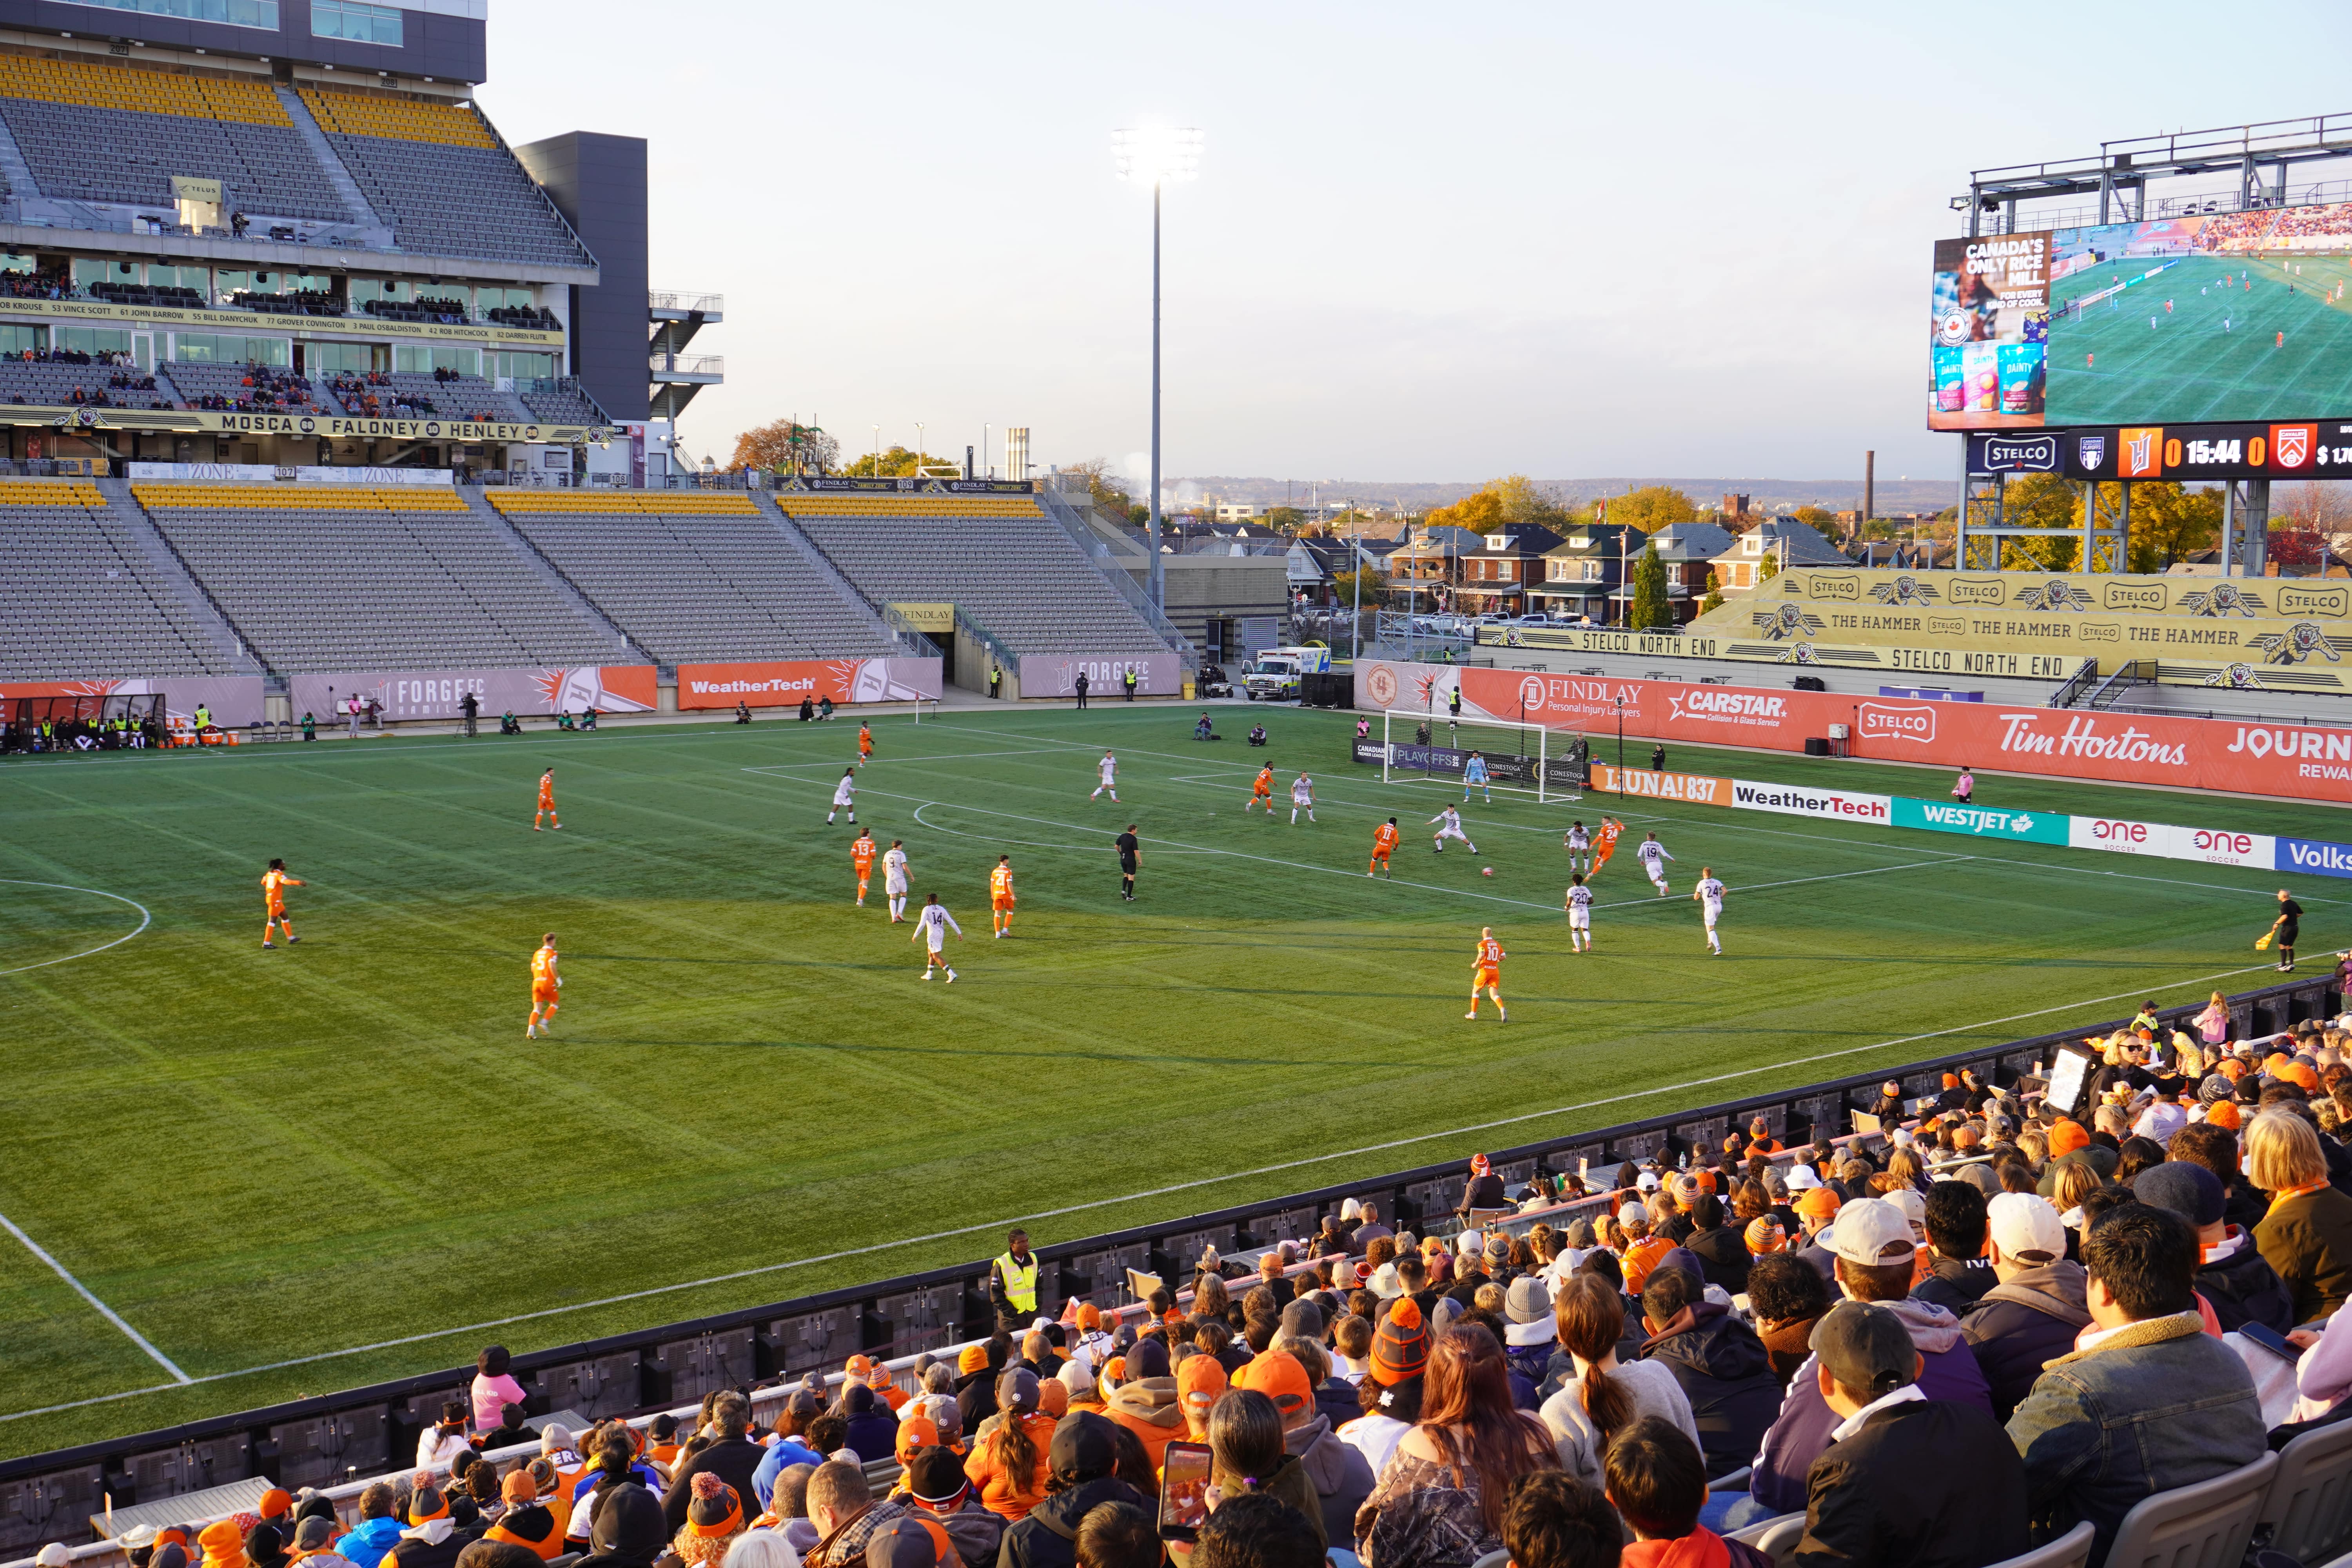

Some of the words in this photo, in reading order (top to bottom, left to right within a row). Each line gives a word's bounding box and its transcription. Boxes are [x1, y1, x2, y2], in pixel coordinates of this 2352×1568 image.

[1966, 238, 2044, 259] CANADA'S
[1966, 257, 2007, 274] ONLY
[2009, 254, 2043, 270] RICE
[2008, 270, 2045, 287] MILL.
[2000, 292, 2016, 300] FOR
[2017, 289, 2043, 298] EVERY
[13, 302, 44, 310] KROUSE
[1986, 301, 2006, 310] KIND
[2007, 300, 2018, 308] OF
[2018, 298, 2045, 307] COOK.
[88, 307, 111, 315] SCOTT
[153, 310, 184, 319] BARROW
[220, 315, 259, 324] DANYCHUK
[277, 318, 304, 327] GROVER
[306, 319, 345, 329] COVINGTON
[377, 324, 421, 333] OSBALDISTON
[454, 328, 488, 337] HITCHCOCK
[222, 416, 292, 431] MOSCA
[333, 419, 419, 435] FALONEY
[450, 423, 519, 438] HENLEY
[1992, 446, 2048, 461] STELCO
[2165, 438, 2182, 468] 0
[2186, 439, 2241, 464] 15:44
[2247, 436, 2266, 466] 0
[191, 464, 234, 479] ZONE
[276, 467, 294, 476] 107
[365, 468, 404, 483] ZONE
[611, 475, 625, 483] 108
[1815, 581, 1854, 593] STELCO
[1955, 586, 1999, 597] STELCO
[2111, 590, 2160, 603] STELCO
[2285, 595, 2340, 608] STELCO
[1831, 614, 1857, 628] THE
[1861, 615, 1921, 630] HAMMER
[1932, 621, 1961, 630] STELCO
[1972, 620, 2001, 635] THE
[2005, 622, 2071, 637] HAMMER
[2083, 628, 2116, 637] STELCO
[2129, 626, 2160, 641] THE
[2165, 628, 2239, 645] HAMMER
[1583, 633, 1629, 651] STELCO
[1640, 635, 1680, 653] NORTH
[1692, 638, 1715, 656] END
[1136, 661, 1149, 674] FC
[1893, 649, 1951, 670] STELCO
[1965, 653, 2017, 673] NORTH
[2032, 656, 2062, 676] END
[398, 679, 464, 703] FORGE
[468, 678, 484, 693] FC
[1088, 682, 1149, 691] AMILON
[1548, 679, 1644, 704] FINDLAY
[398, 704, 485, 715] HAMILTN
[1548, 701, 1581, 713] Personal
[1583, 706, 1606, 717] Injury
[1707, 713, 1732, 723] Collision
[1740, 717, 1756, 725] Glass
[1757, 718, 1780, 727] Service
[1867, 713, 1927, 731] STELCO
[1999, 714, 2055, 755] Tim
[2060, 716, 2185, 766] Hortons
[1357, 745, 1385, 754] CANADIAN
[1487, 762, 1521, 772] CONESTOGA
[2299, 763, 2352, 780] REWA
[1550, 769, 1585, 779] CONESTOGA
[1687, 777, 1717, 801] 837
[1922, 805, 2011, 833] WESTJET
[1383, 829, 1391, 840] 11
[1606, 829, 1618, 840] 24
[2092, 820, 2148, 843] one
[2105, 844, 2136, 853] SOCCER
[2193, 831, 2252, 854] one
[857, 844, 869, 856] 13
[1646, 847, 1657, 857] 19
[889, 857, 895, 868] 9
[2206, 855, 2239, 864] SOCCER
[995, 873, 1005, 886] 21
[1705, 885, 1719, 898] 24
[1574, 893, 1587, 904] 20
[932, 912, 942, 925] 14
[1486, 946, 1499, 962] 10
[537, 955, 545, 971] 5
